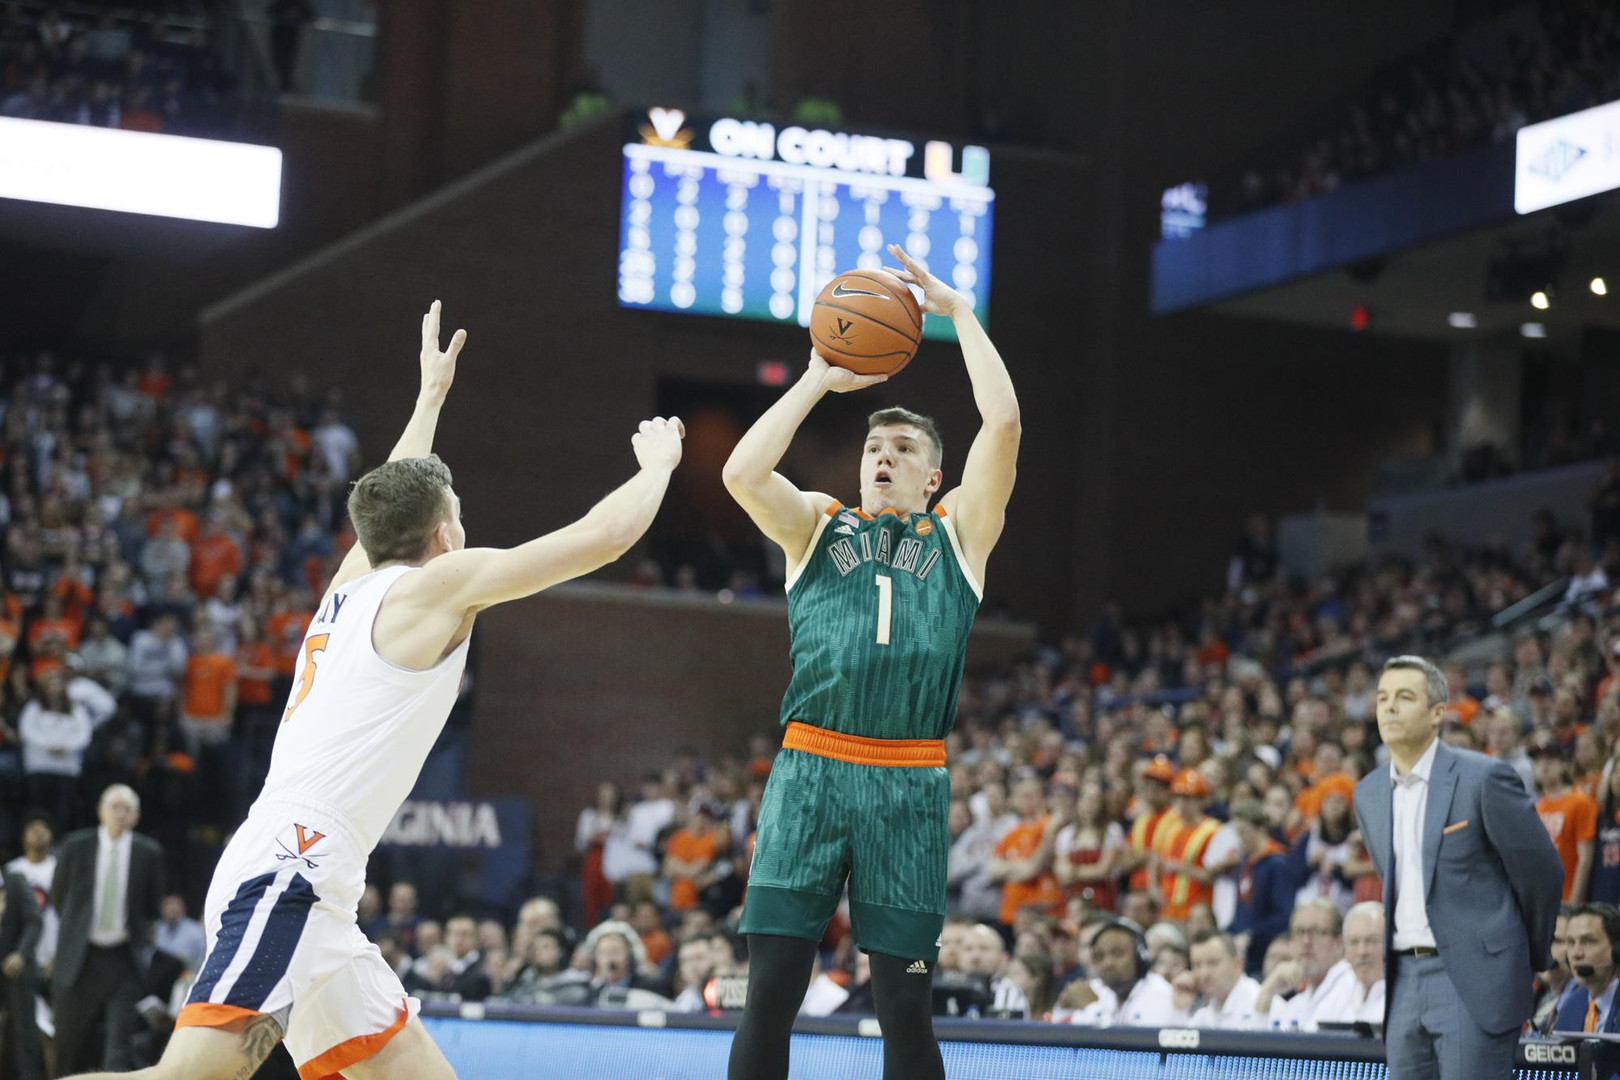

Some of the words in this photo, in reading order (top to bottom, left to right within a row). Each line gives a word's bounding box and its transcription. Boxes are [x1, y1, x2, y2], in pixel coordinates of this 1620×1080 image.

[709, 117, 775, 161] ON
[777, 126, 915, 177] COURT
[836, 317, 854, 336] V
[827, 527, 941, 581] MIAMI
[875, 574, 892, 645] 1
[284, 632, 331, 723] 5
[293, 822, 327, 856] V
[1524, 1043, 1576, 1064] GEICO
